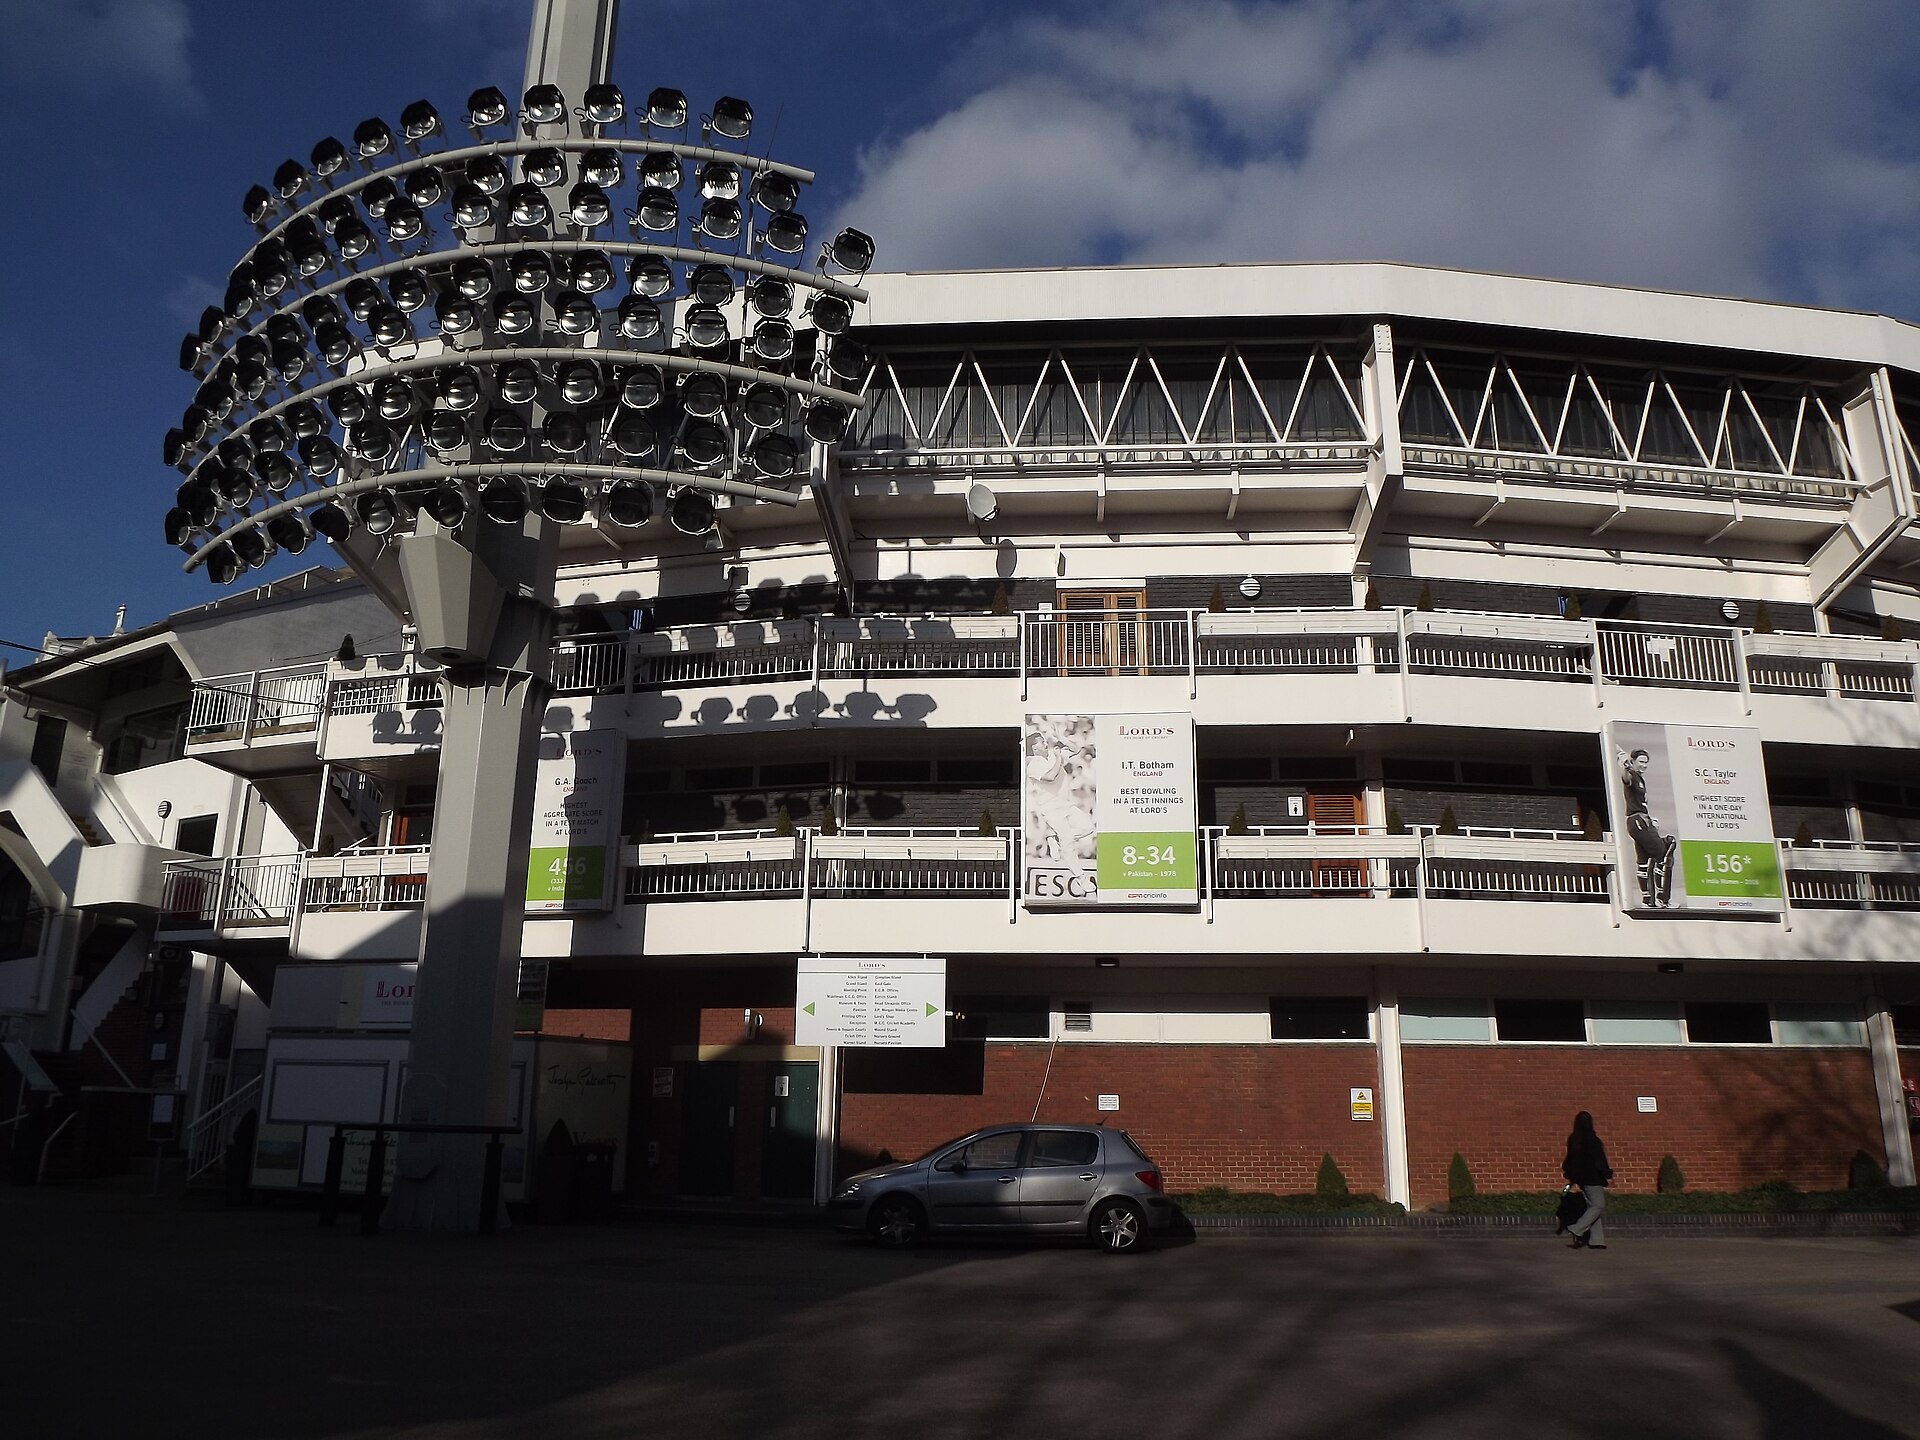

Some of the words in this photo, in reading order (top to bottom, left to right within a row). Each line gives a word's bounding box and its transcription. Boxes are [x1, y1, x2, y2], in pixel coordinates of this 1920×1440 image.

[1121, 761, 1136, 770] I.T.
[1139, 761, 1174, 770] Botham
[1694, 768, 1711, 777] S.C.
[1713, 770, 1737, 779] Taylor
[554, 777, 570, 786] G.A.
[574, 776, 598, 784] Gooch
[1696, 812, 1748, 820] INTERNATIONAL
[1122, 846, 1176, 865] 8-34
[548, 858, 587, 876] 456
